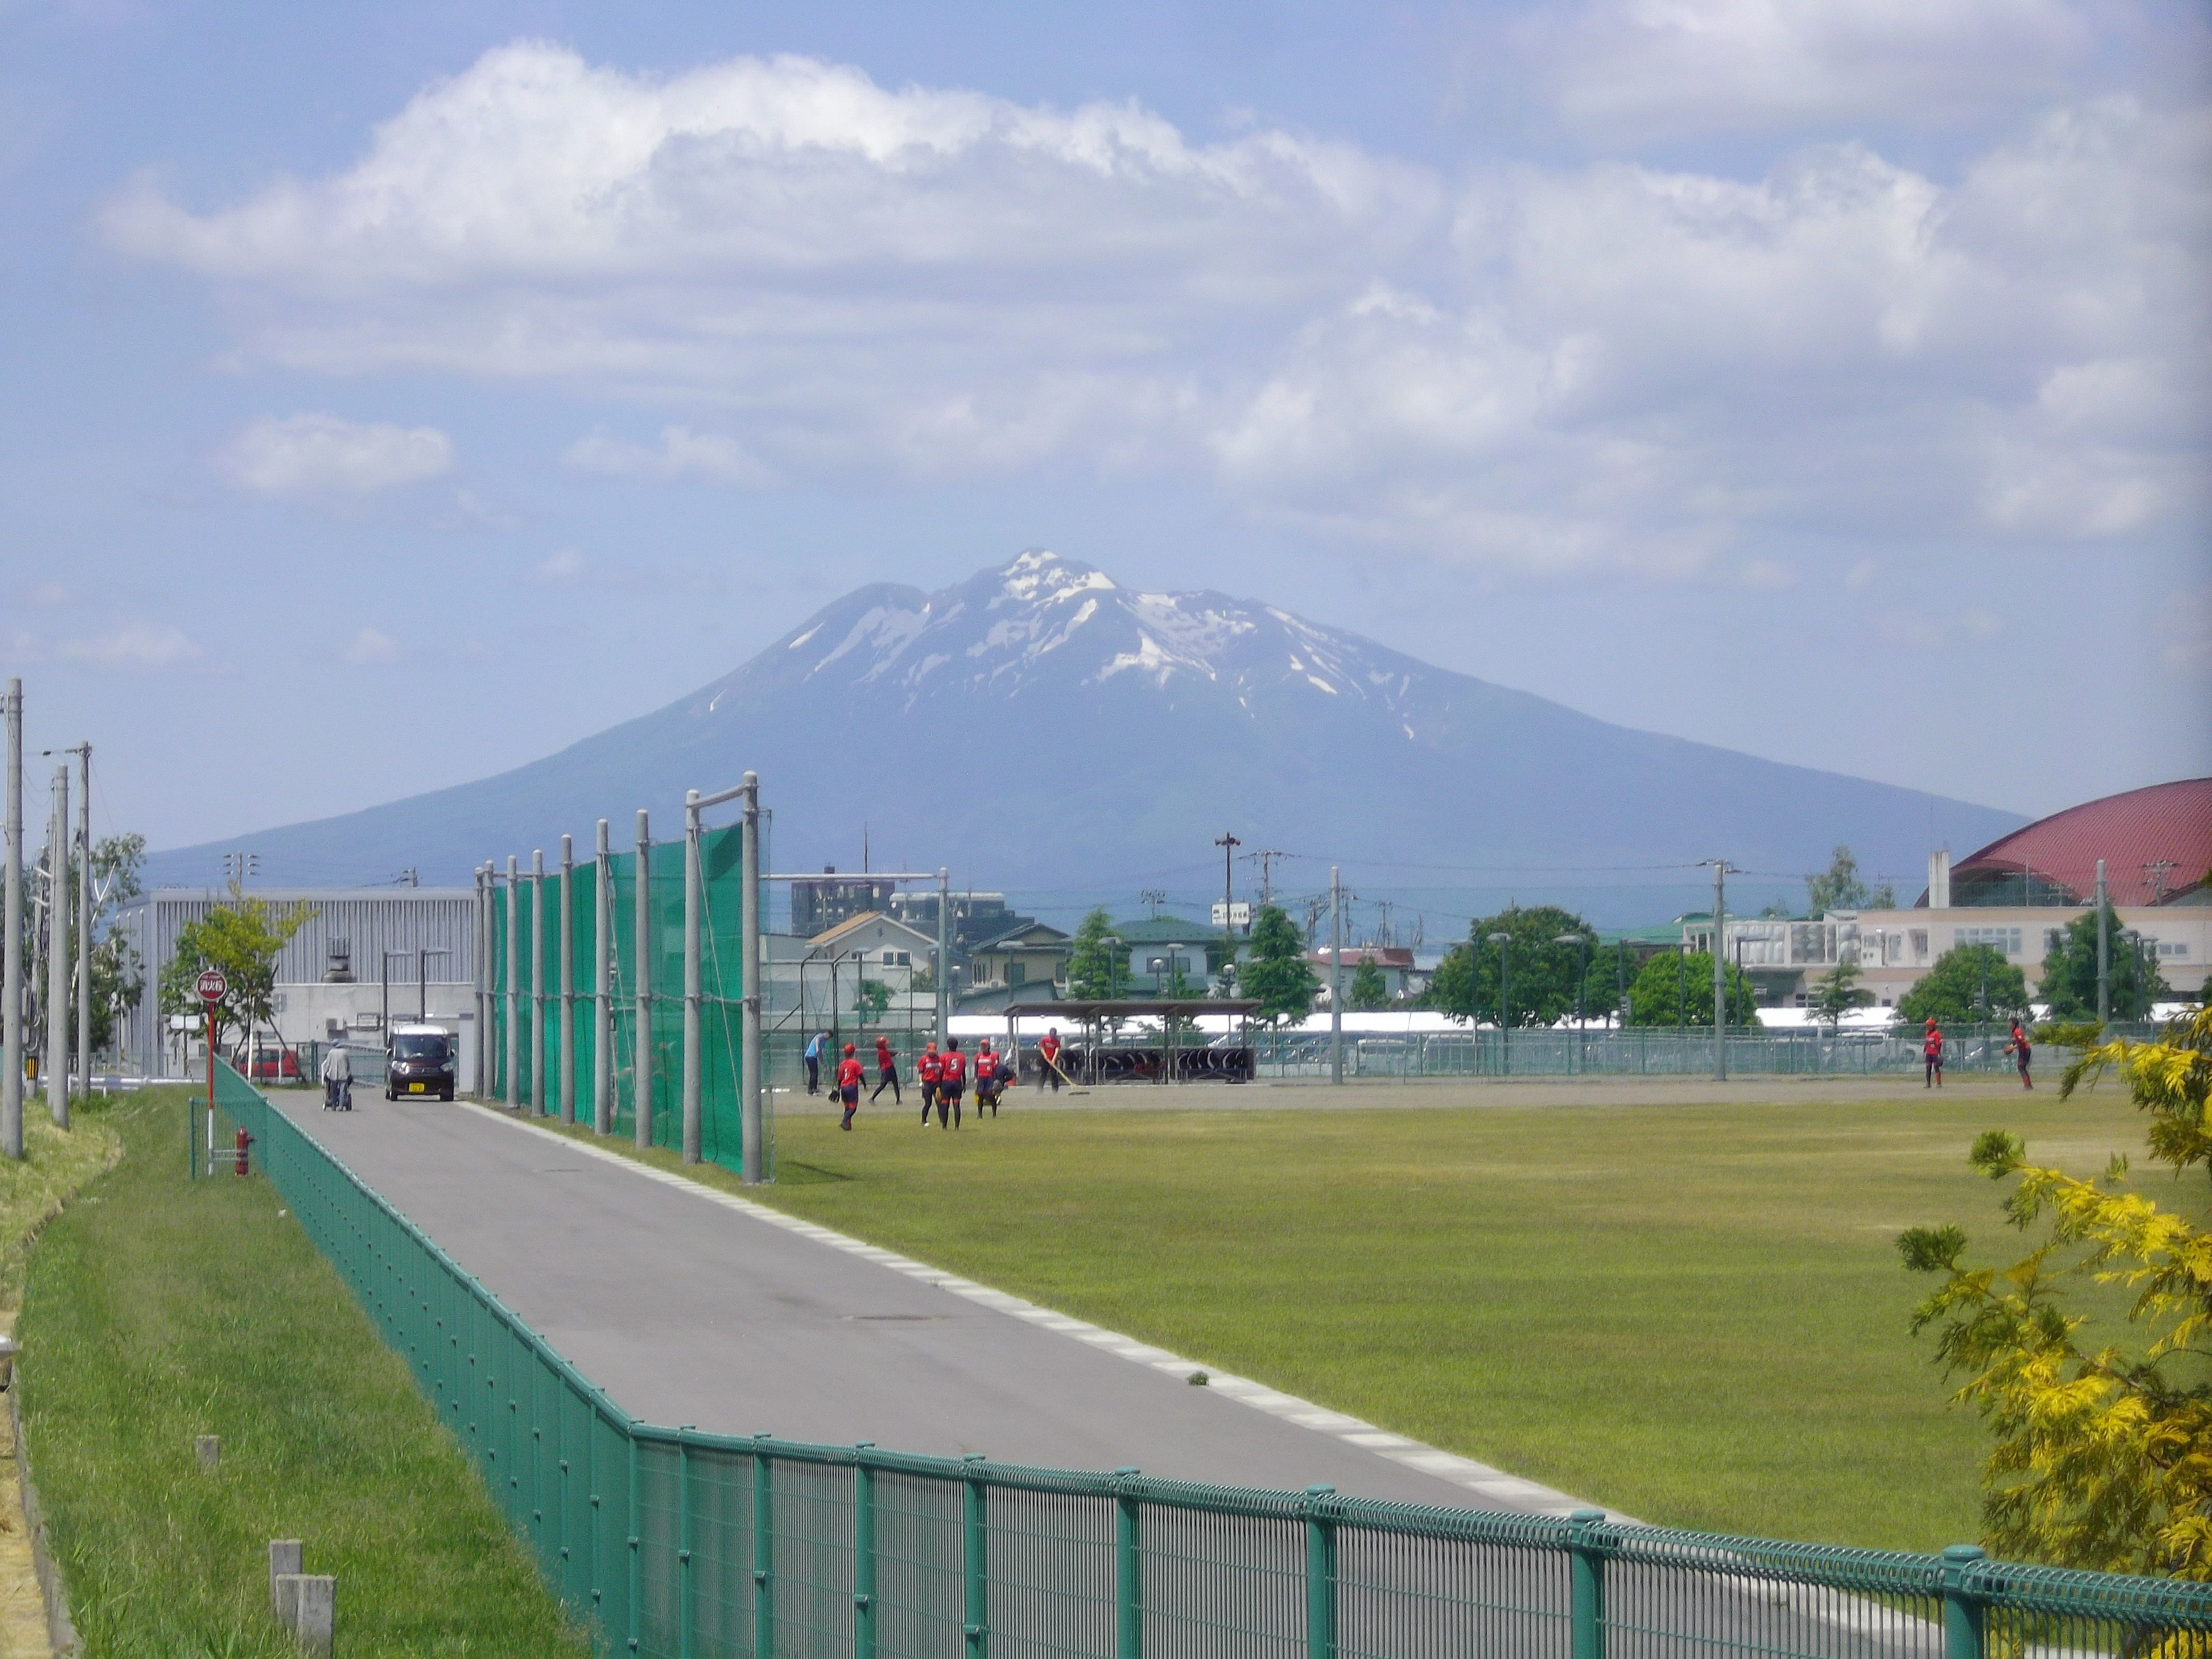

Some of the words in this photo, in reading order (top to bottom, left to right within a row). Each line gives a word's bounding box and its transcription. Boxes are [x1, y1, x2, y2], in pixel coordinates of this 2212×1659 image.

[200, 980, 223, 991] 消火栓
[950, 1058, 957, 1070] 5
